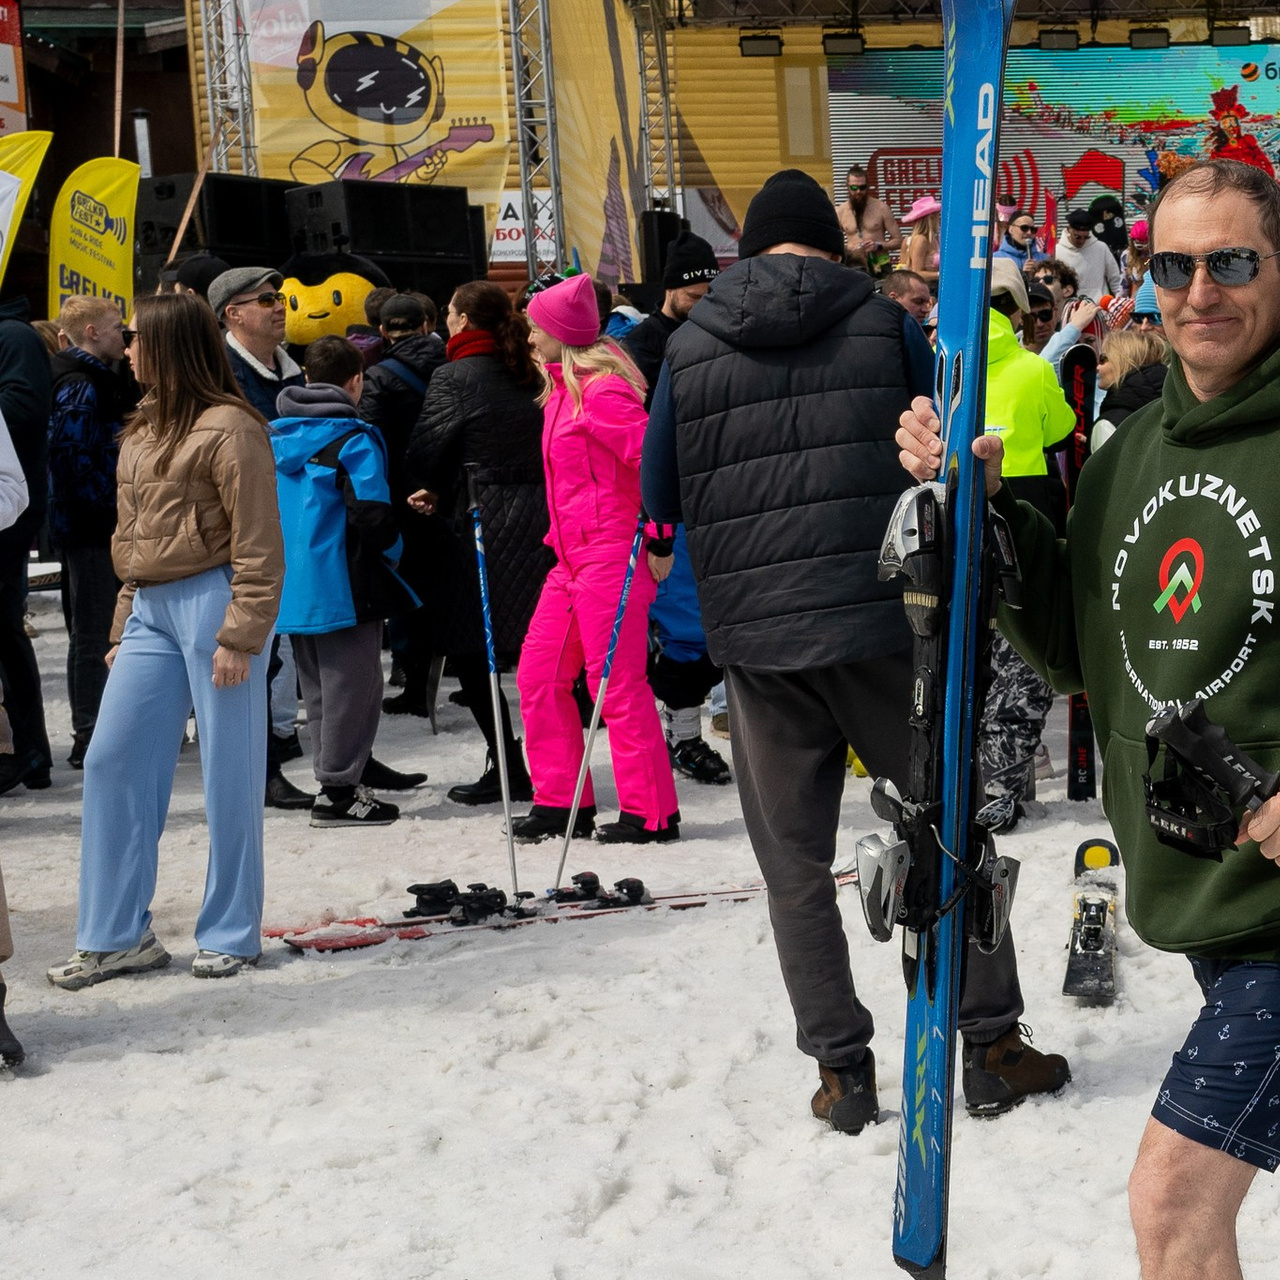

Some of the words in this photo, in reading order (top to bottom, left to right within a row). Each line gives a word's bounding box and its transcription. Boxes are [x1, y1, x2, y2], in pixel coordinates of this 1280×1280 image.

[884, 159, 942, 185] GREL
[970, 82, 995, 269] HEAD
[74, 208, 96, 224] FEST
[76, 195, 104, 218] GRELKA
[496, 228, 557, 241] БОКА
[1112, 473, 1275, 624] NOVOKUZNETSK
[1148, 639, 1169, 650] EST.
[1172, 639, 1199, 651] 1952
[1195, 633, 1258, 701] AIRPORT
[347, 801, 373, 819] N
[1150, 814, 1187, 838] LEKI
